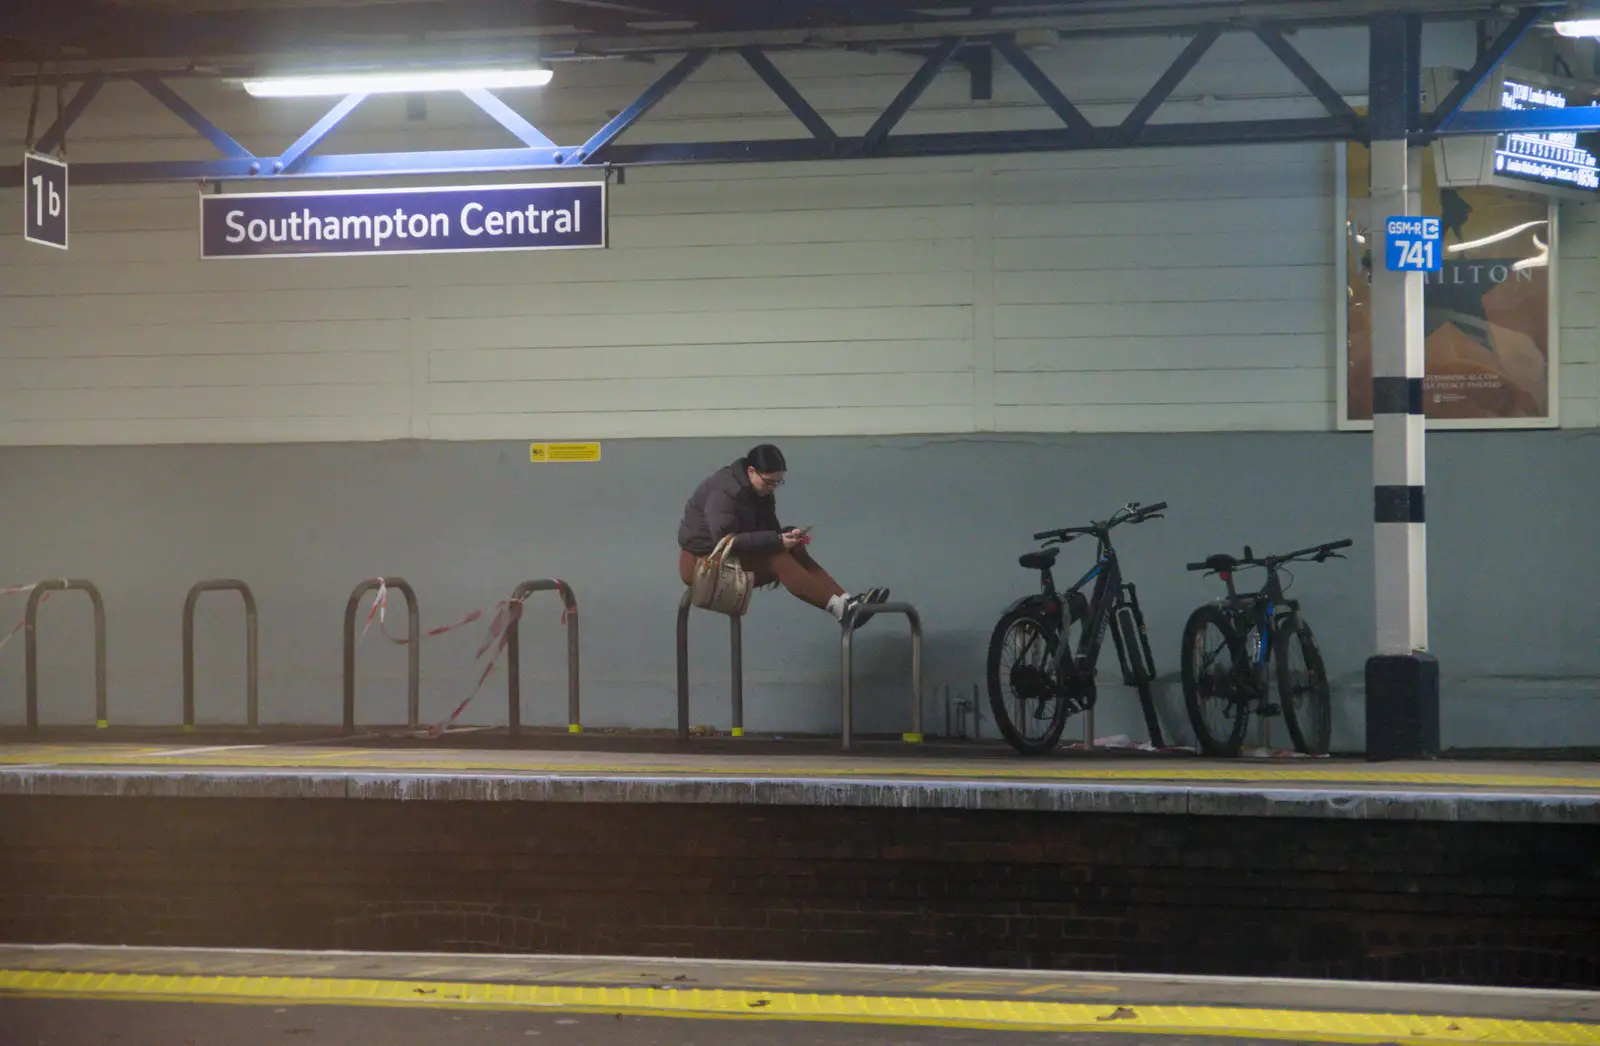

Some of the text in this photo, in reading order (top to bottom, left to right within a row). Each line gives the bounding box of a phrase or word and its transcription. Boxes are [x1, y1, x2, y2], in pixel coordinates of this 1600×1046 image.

[225, 200, 581, 247] Southampton Central
[1388, 221, 1421, 234] GSM-R
[1394, 240, 1433, 269] 741
